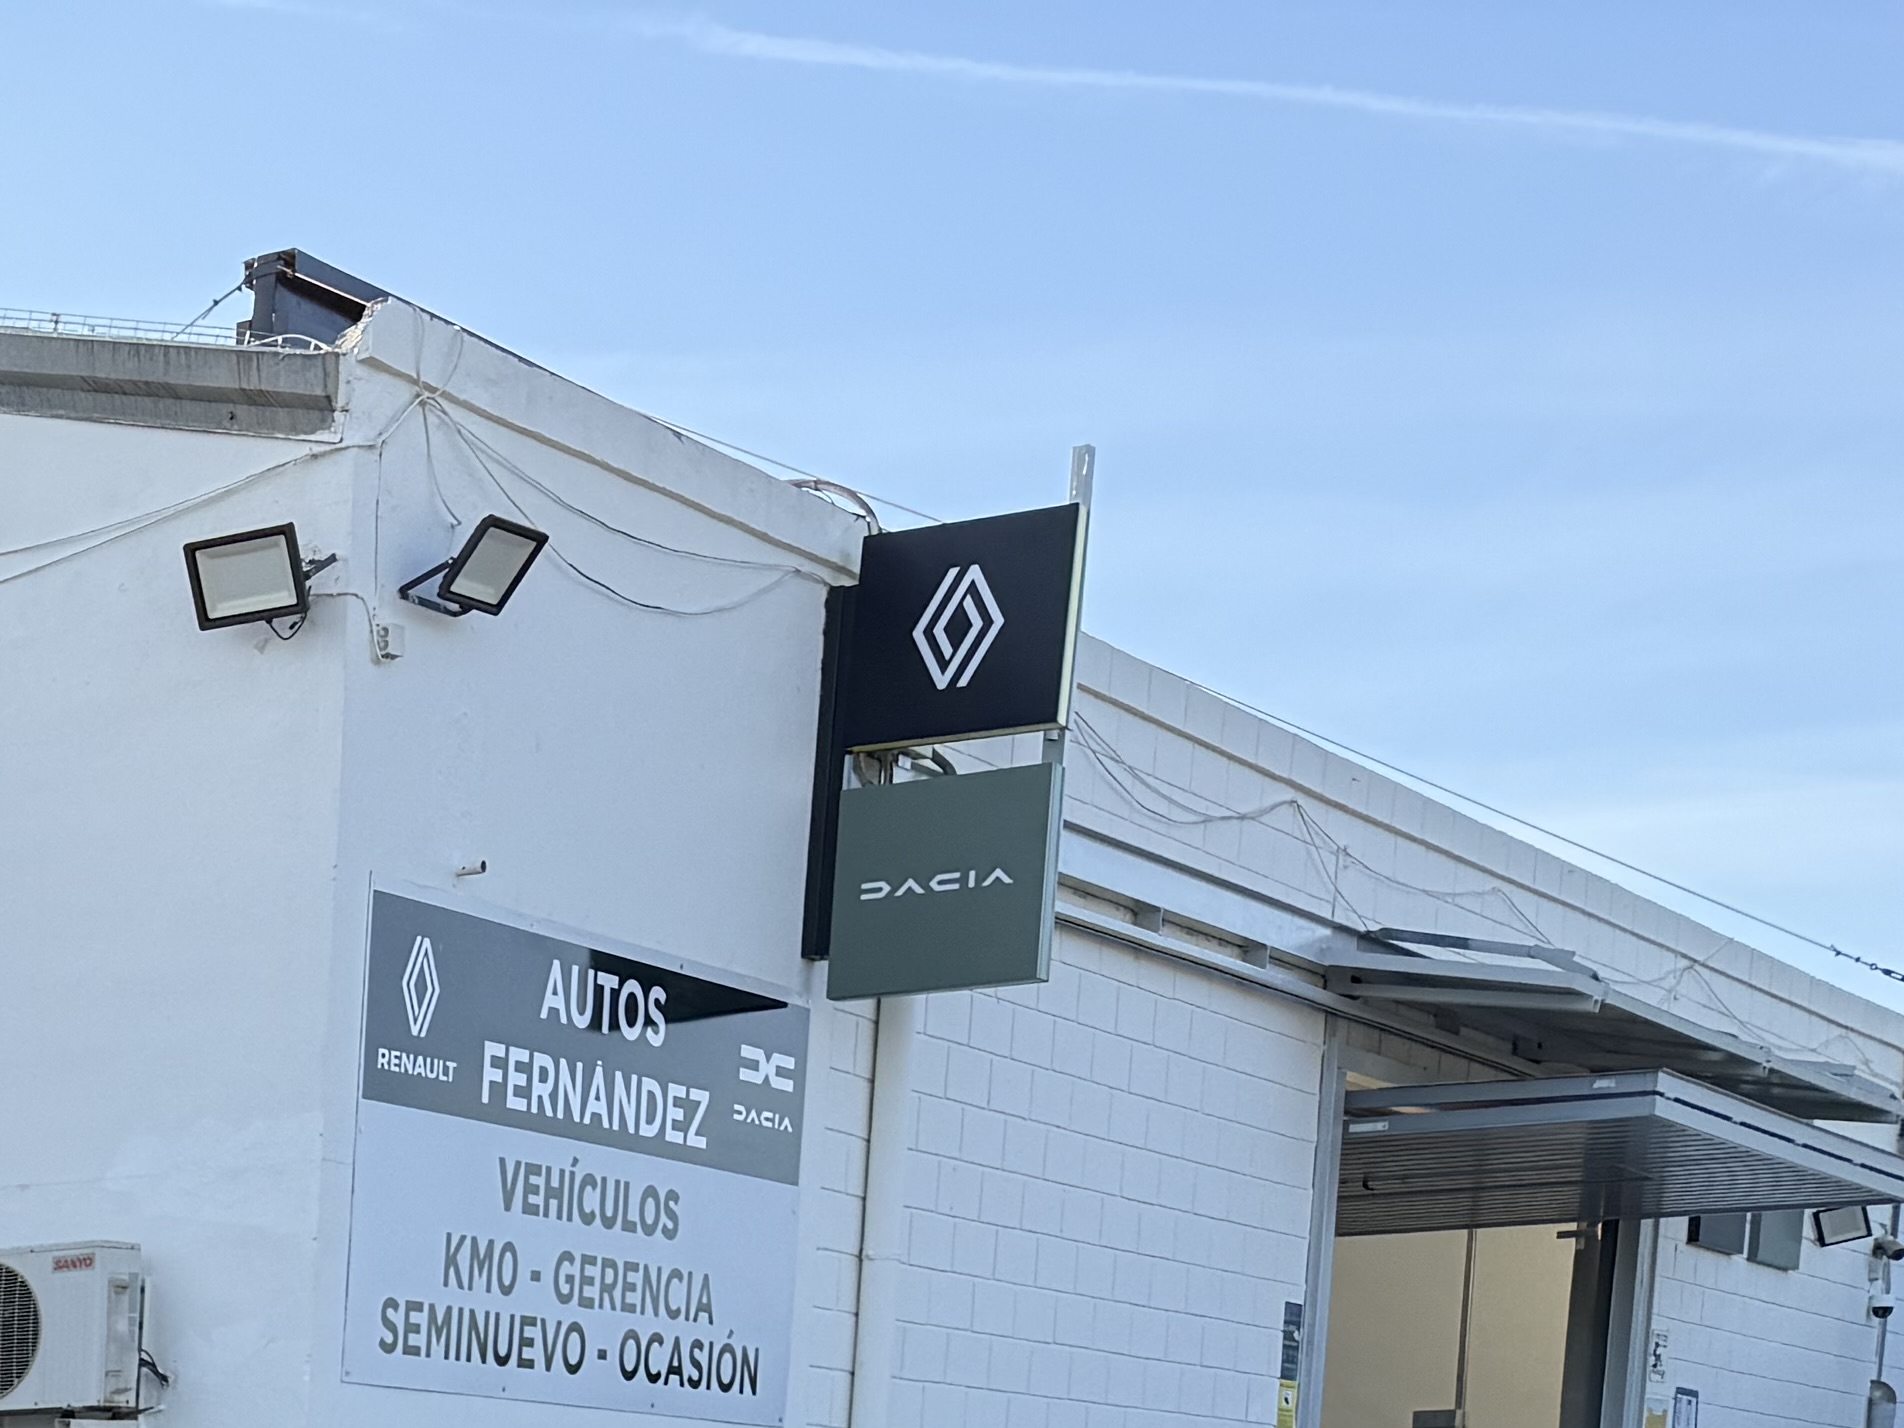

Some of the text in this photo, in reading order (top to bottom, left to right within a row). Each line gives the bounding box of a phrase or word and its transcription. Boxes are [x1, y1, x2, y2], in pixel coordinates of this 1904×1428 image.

[860, 866, 1014, 901] DACIA
[539, 958, 667, 1047] AUTOS
[377, 1047, 458, 1083] RENAULT
[732, 1103, 793, 1133] DACIA
[498, 1155, 680, 1242] VEHÍCULOS
[553, 1250, 714, 1326] GERENCIA
[378, 1297, 586, 1376] SEMINUEVO
[619, 1328, 760, 1397] OCASIÓN
